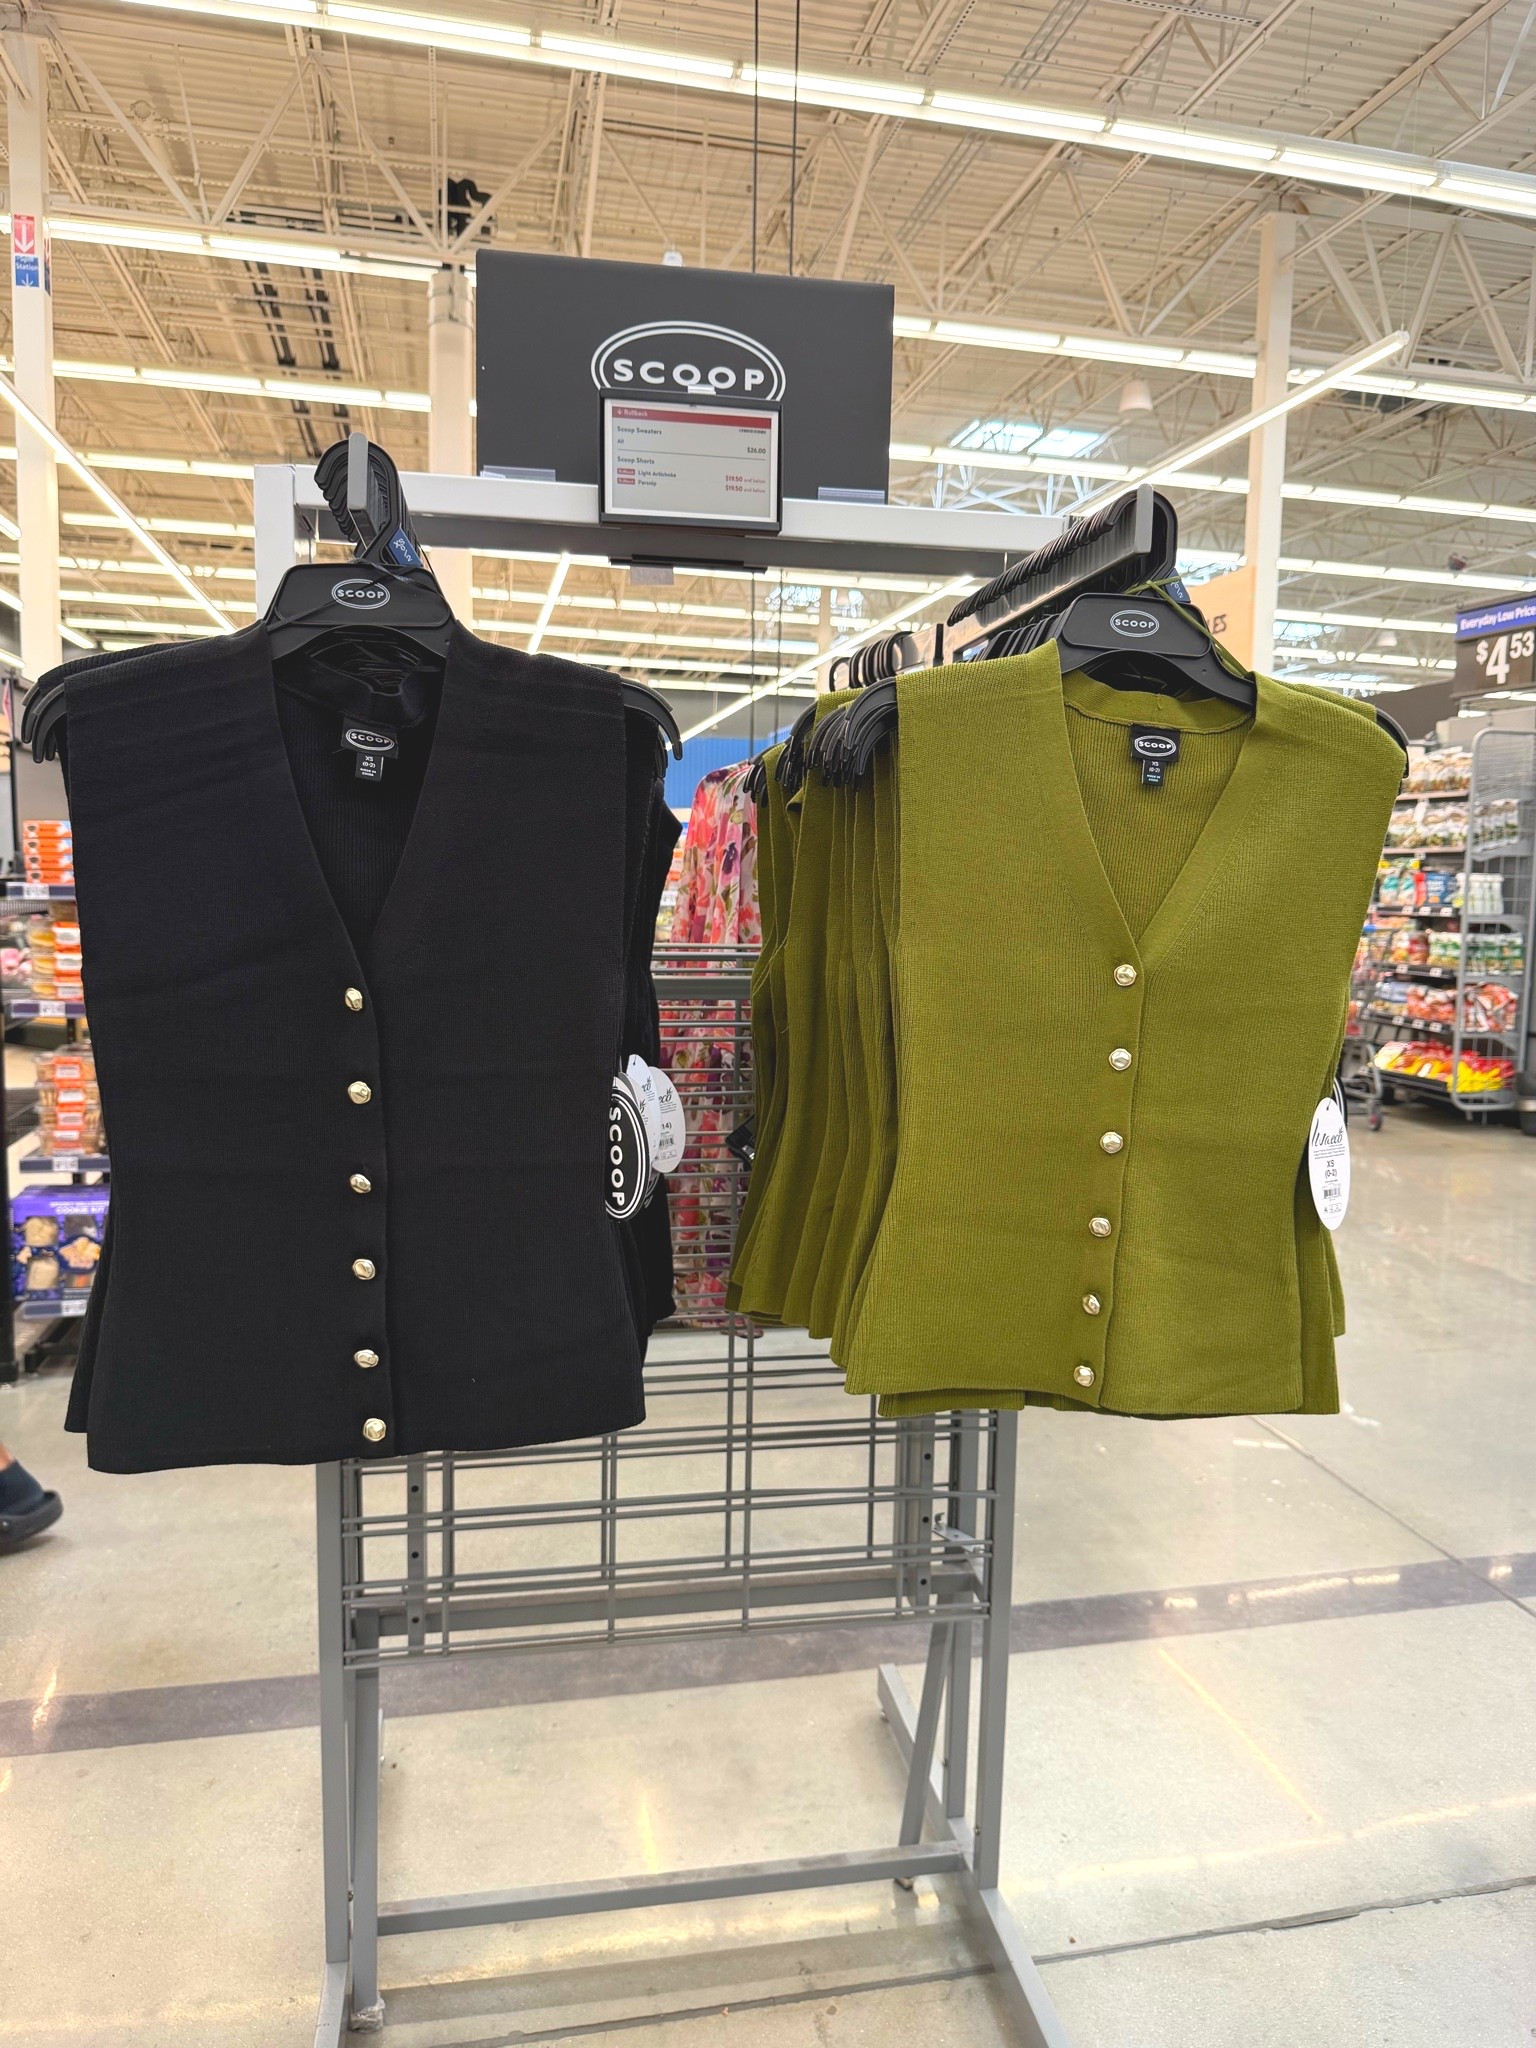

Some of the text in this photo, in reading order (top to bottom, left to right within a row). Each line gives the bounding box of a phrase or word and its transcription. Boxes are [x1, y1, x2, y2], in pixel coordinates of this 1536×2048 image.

[613, 359, 765, 391] SCOOP
[623, 409, 648, 417] Rollback
[617, 426, 662, 435] Scoop Sweaters
[747, 446, 767, 454] $26.00
[617, 456, 655, 465] Scoop Shorts
[725, 475, 743, 483] $19.50
[725, 484, 743, 492] $19.50
[337, 589, 385, 599] SCOOP
[1115, 618, 1155, 629] SCOOP
[1460, 614, 1497, 630] Everyday
[1497, 610, 1515, 623] Low
[351, 733, 390, 744] SCOOP
[1139, 741, 1172, 749] SCOOP
[609, 1107, 625, 1206] SCOOP
[1326, 1160, 1335, 1168] XS
[1325, 1168, 1338, 1179] (0-2)
